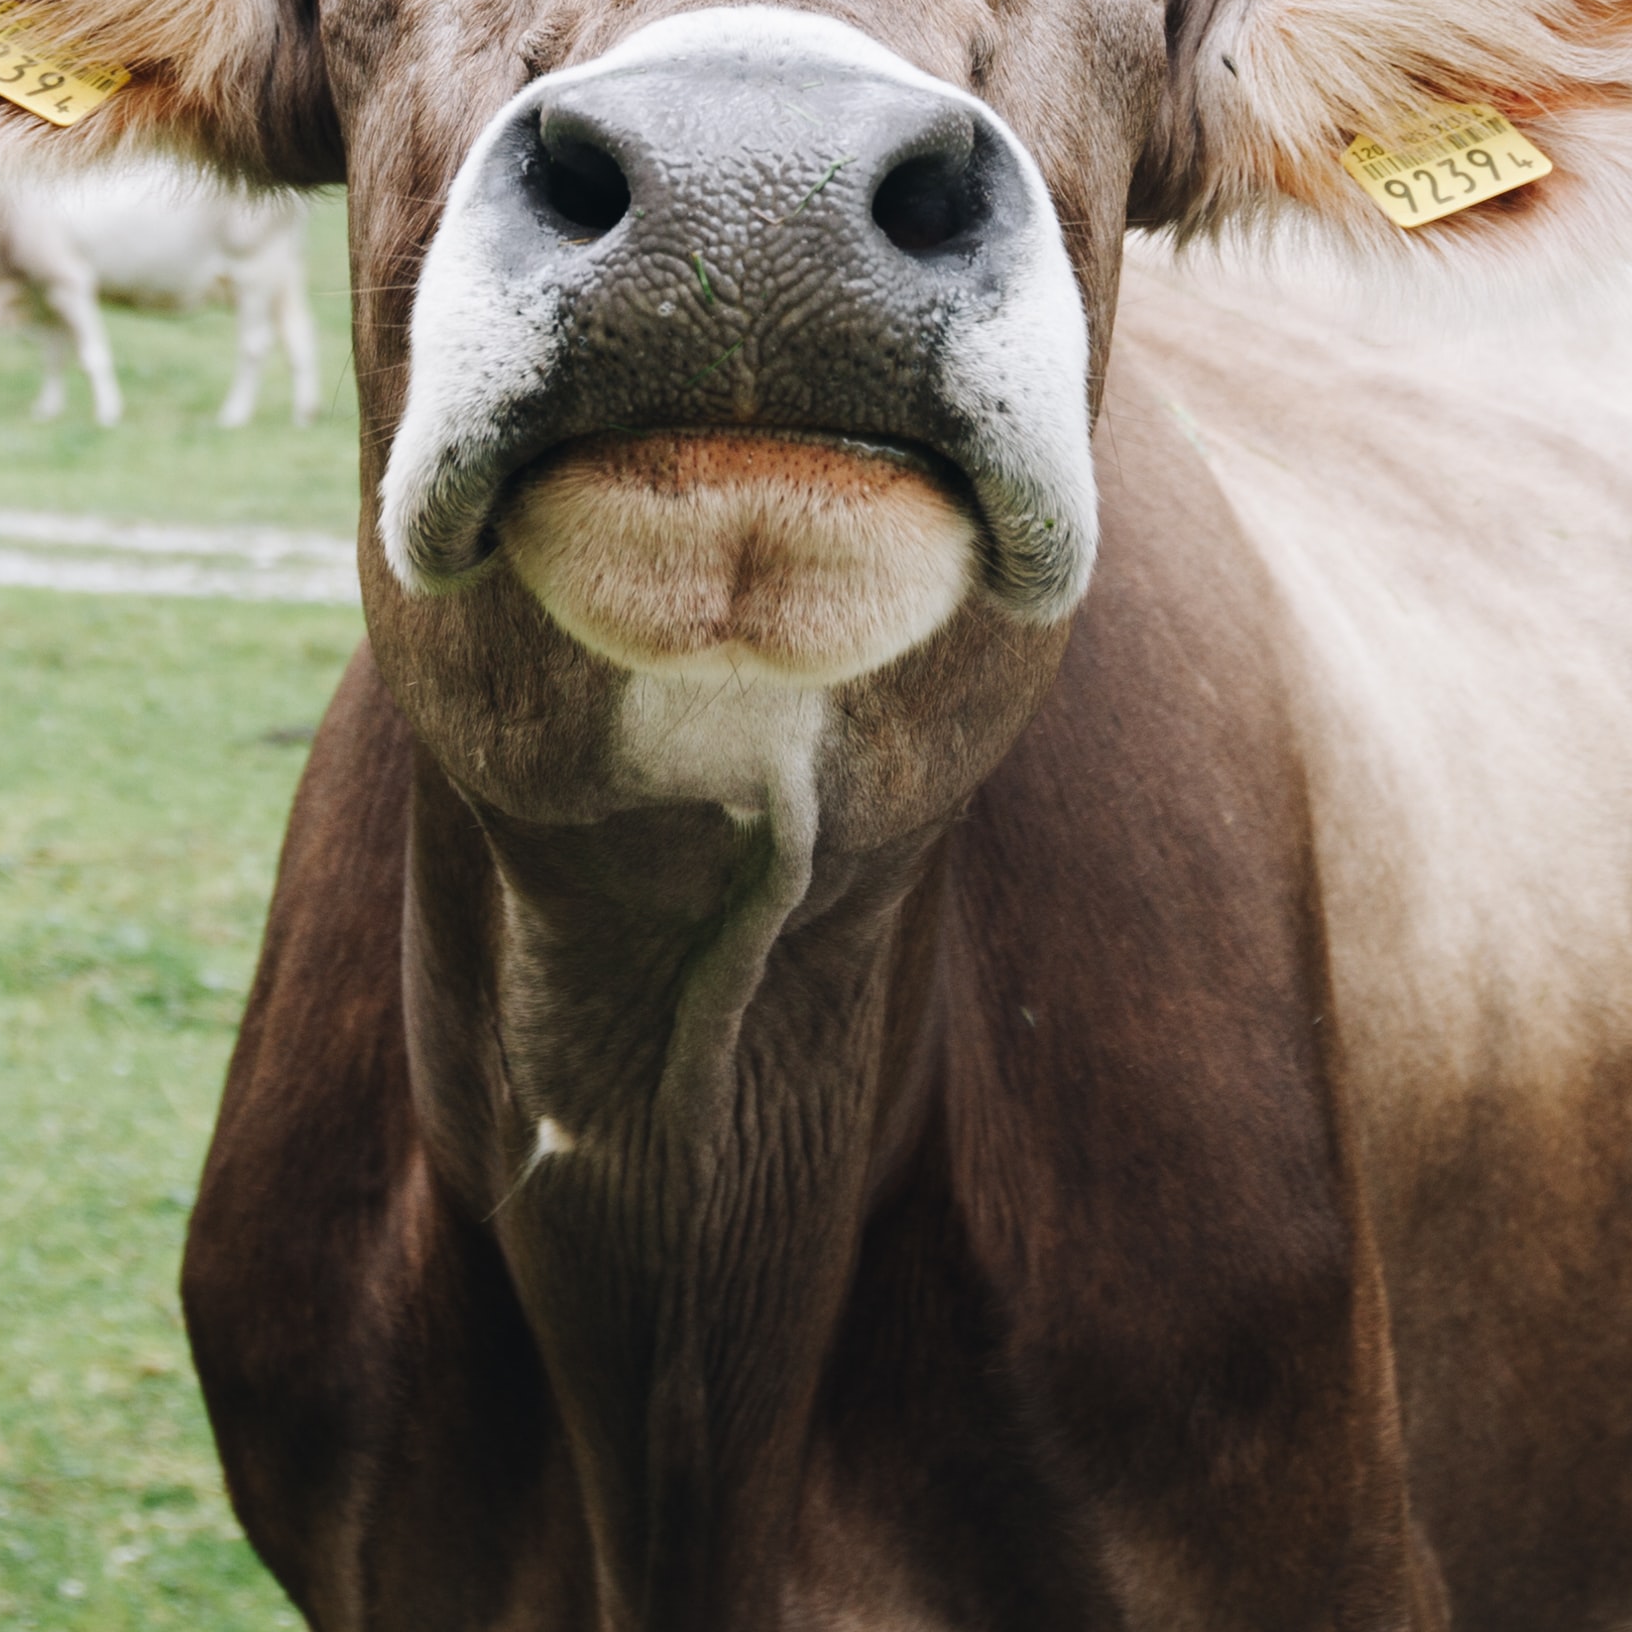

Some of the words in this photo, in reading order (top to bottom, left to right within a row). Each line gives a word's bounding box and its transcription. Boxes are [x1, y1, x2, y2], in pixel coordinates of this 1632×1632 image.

[1352, 144, 1385, 164] 120
[1384, 148, 1502, 214] 9239
[1507, 152, 1534, 169] 4
